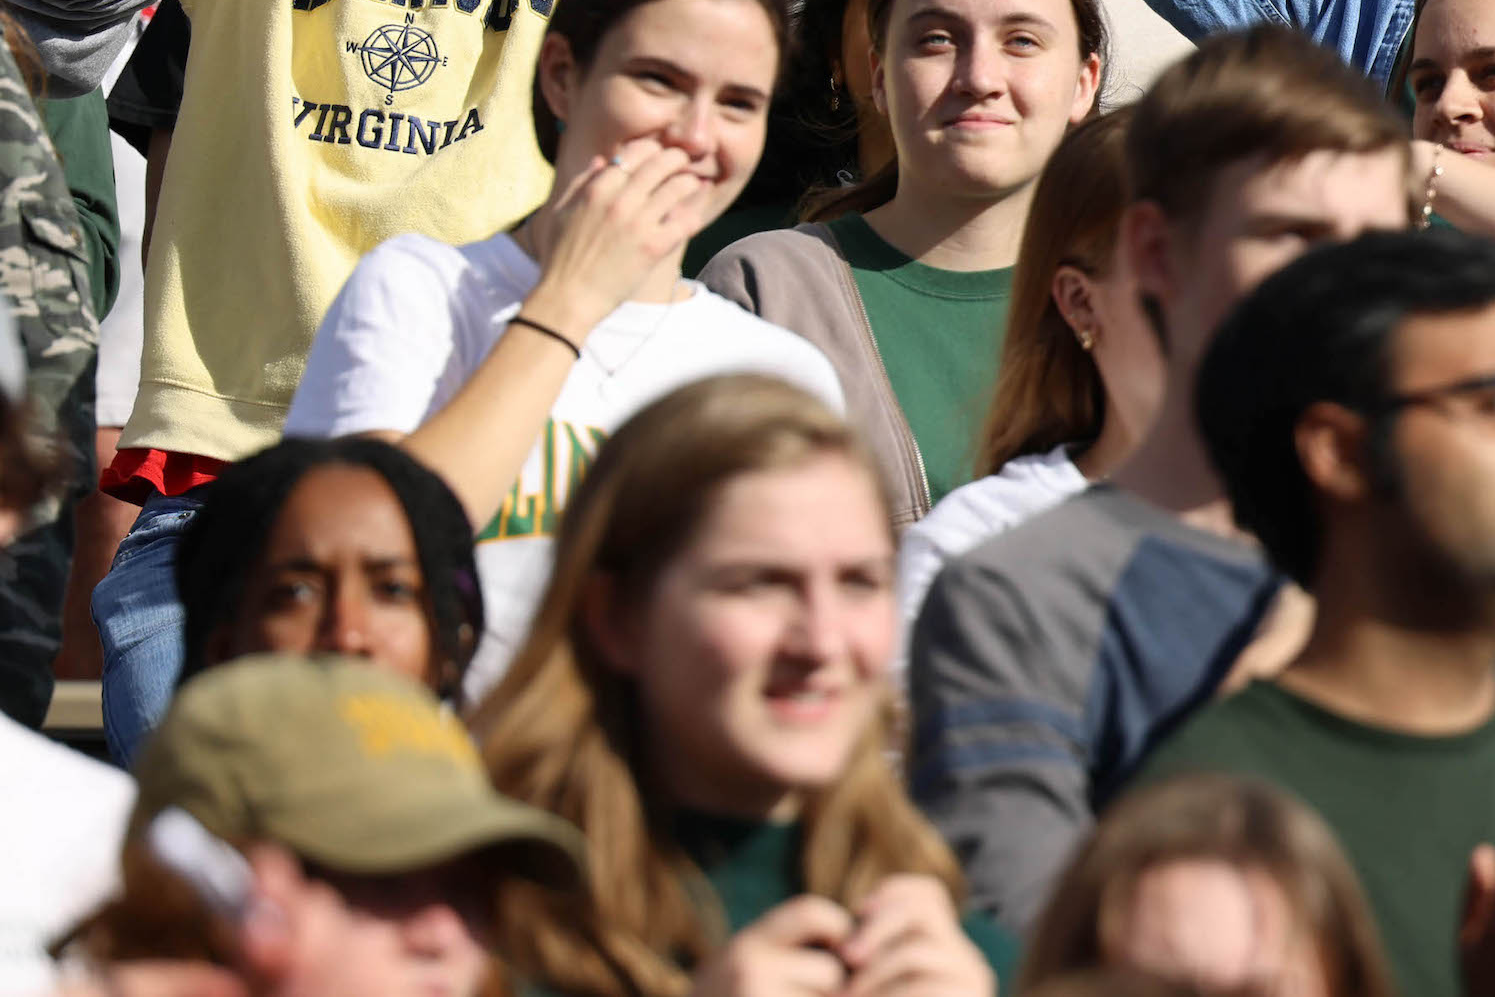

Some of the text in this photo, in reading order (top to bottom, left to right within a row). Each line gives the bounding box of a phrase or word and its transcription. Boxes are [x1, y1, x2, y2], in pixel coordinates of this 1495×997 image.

[404, 13, 415, 24] N
[345, 41, 359, 53] W
[442, 56, 448, 67] E
[384, 94, 394, 106] S
[292, 96, 485, 155] VIRGINIA
